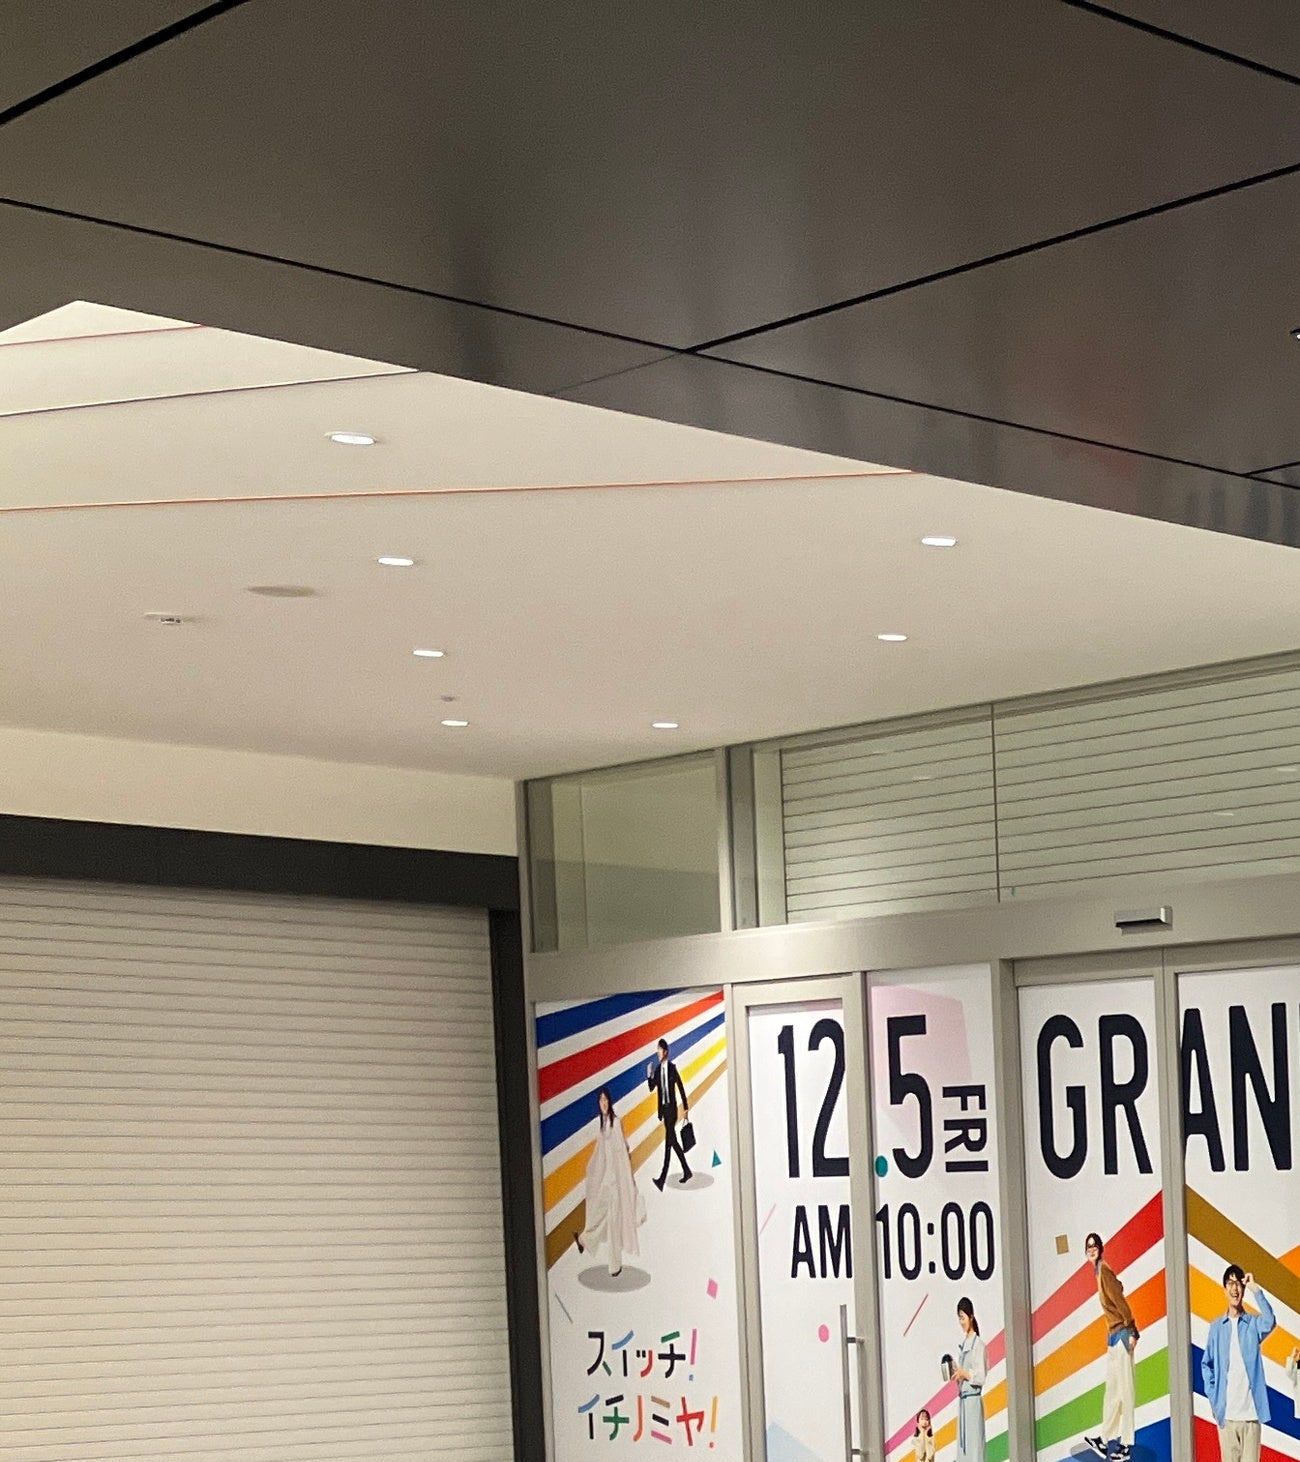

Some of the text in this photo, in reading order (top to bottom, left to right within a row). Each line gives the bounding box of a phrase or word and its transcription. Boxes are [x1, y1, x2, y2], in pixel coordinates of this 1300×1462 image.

[777, 1014, 989, 1178] 12.5 FRI
[791, 1201, 995, 1280] AM 10:00
[587, 1328, 697, 1381] スイッチ!
[578, 1393, 719, 1448] イチノミヤ!
